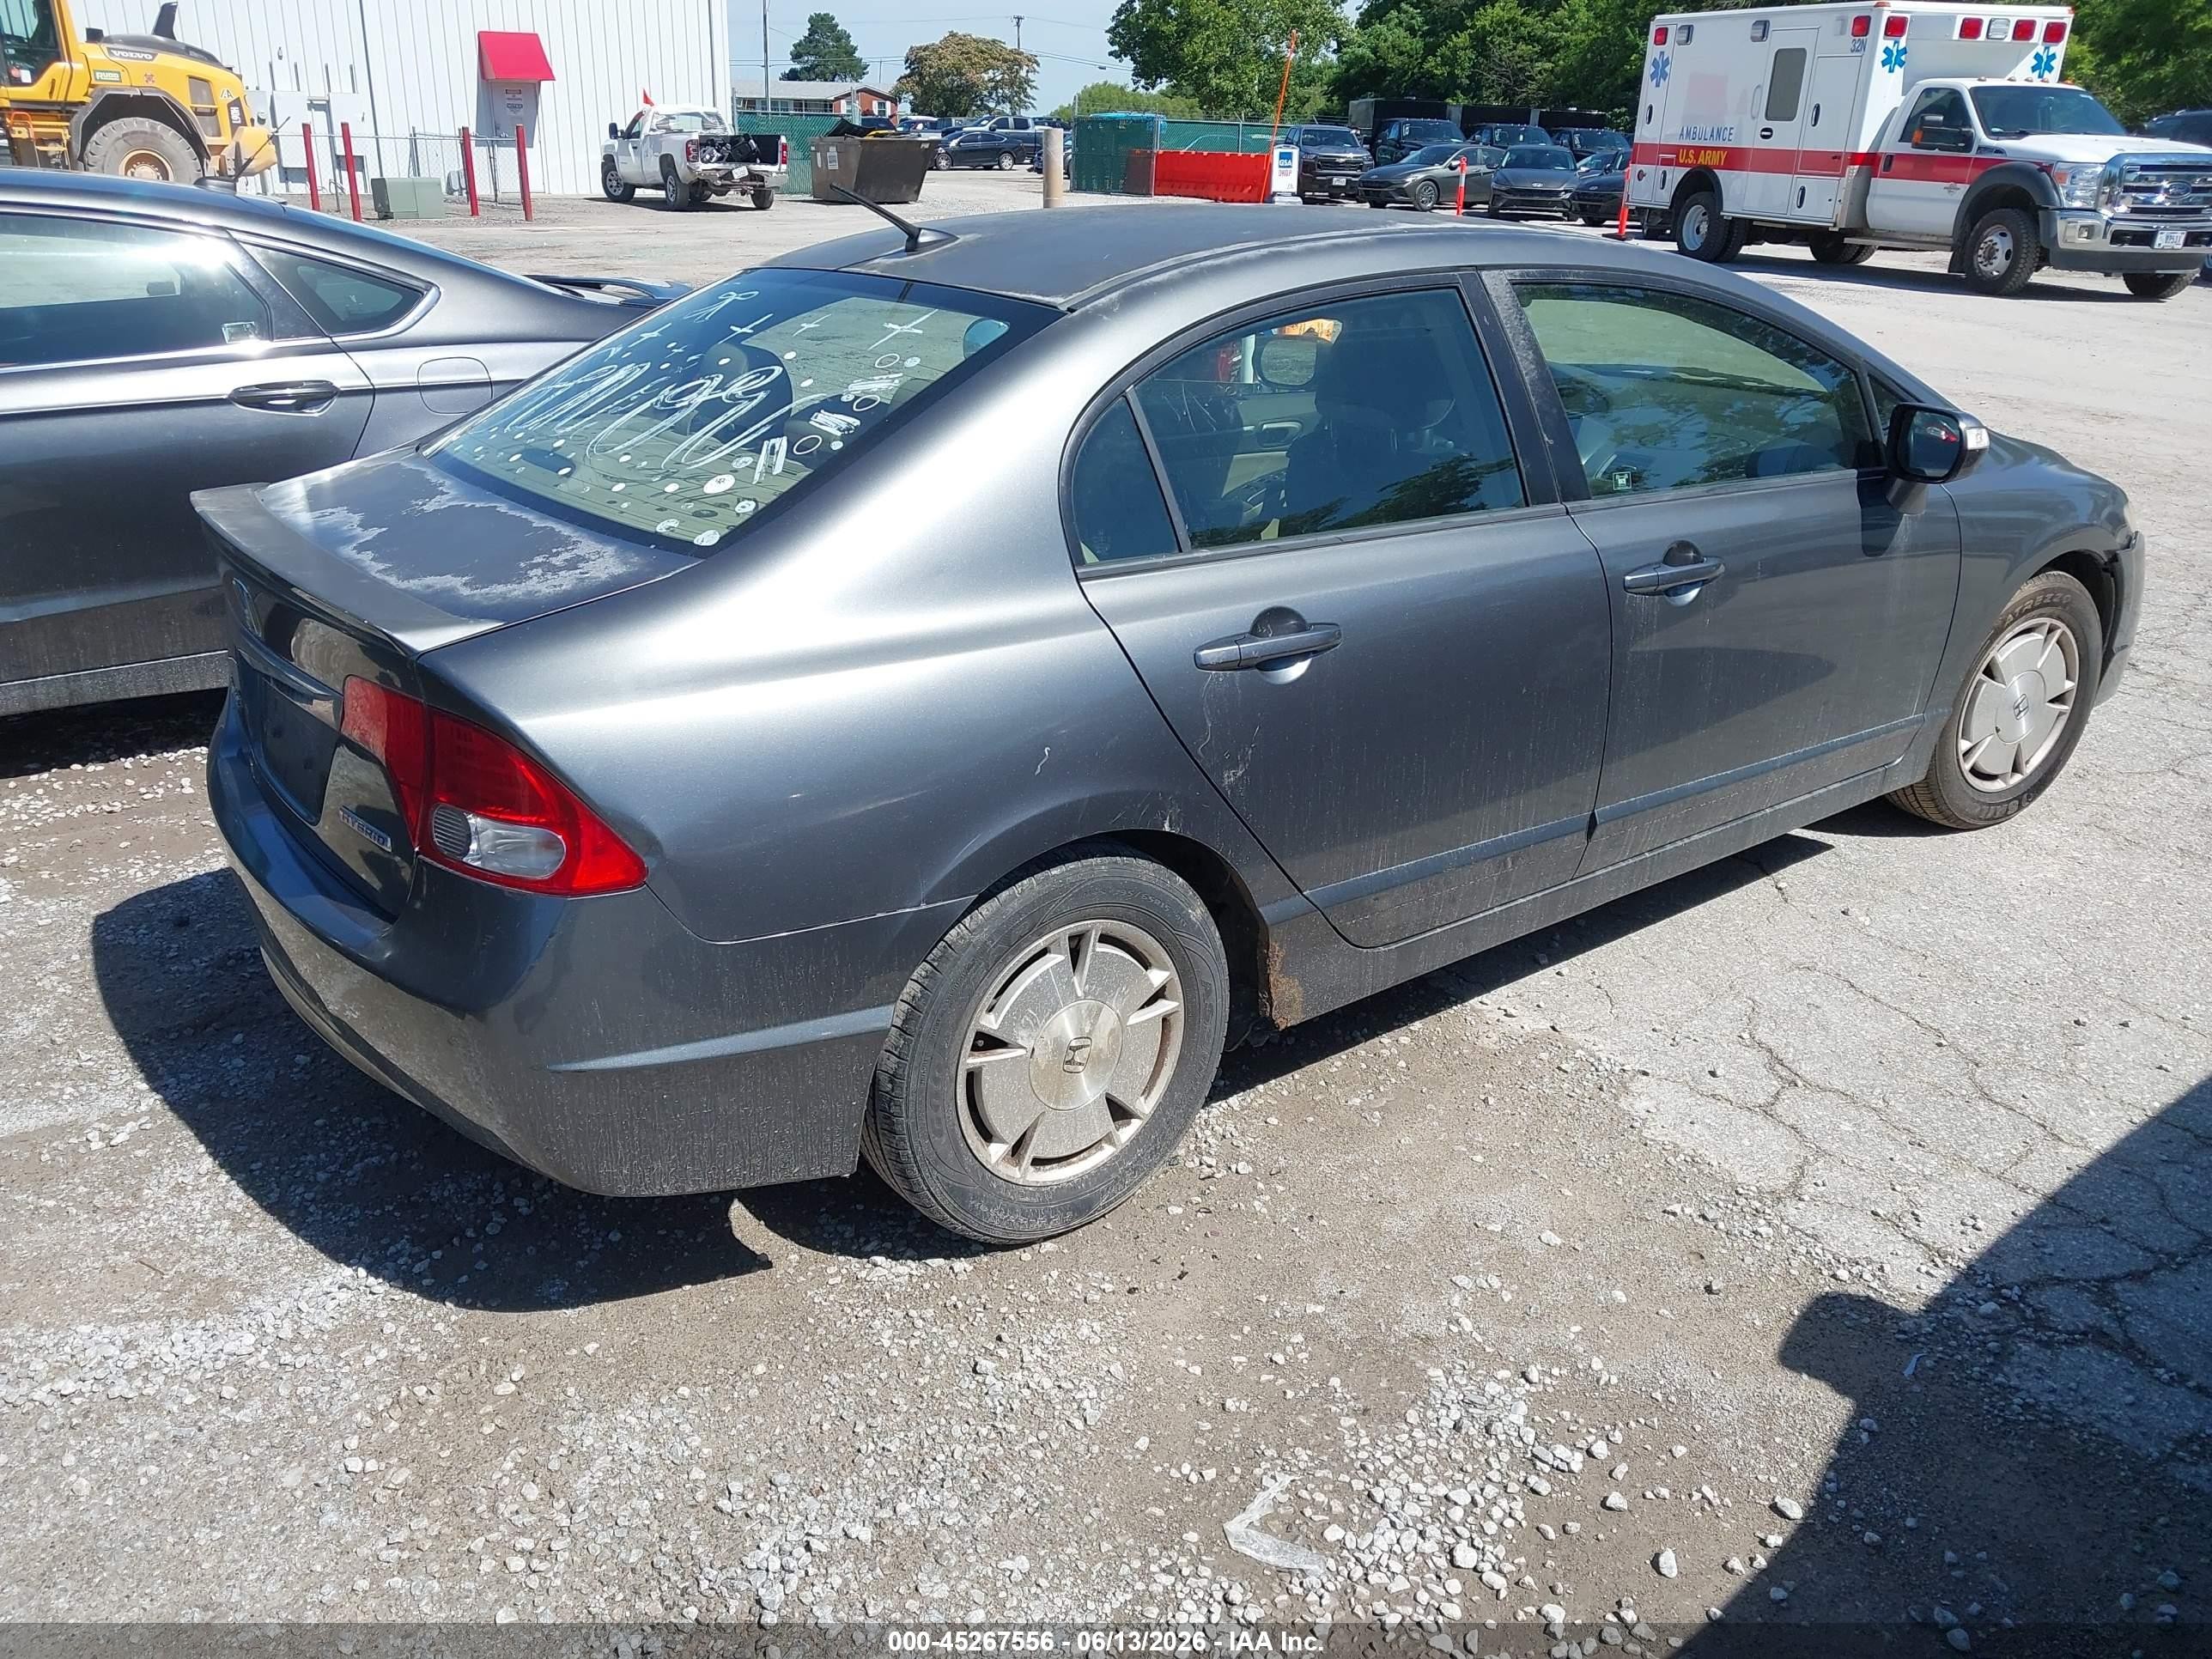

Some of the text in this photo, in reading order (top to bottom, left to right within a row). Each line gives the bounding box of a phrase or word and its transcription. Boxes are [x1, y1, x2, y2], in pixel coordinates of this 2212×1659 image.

[1850, 38, 1867, 52] 32N
[111, 50, 153, 59] VOLVO
[1679, 125, 1735, 142] AMBULANCE
[1679, 149, 1728, 166] U.S. ARMY
